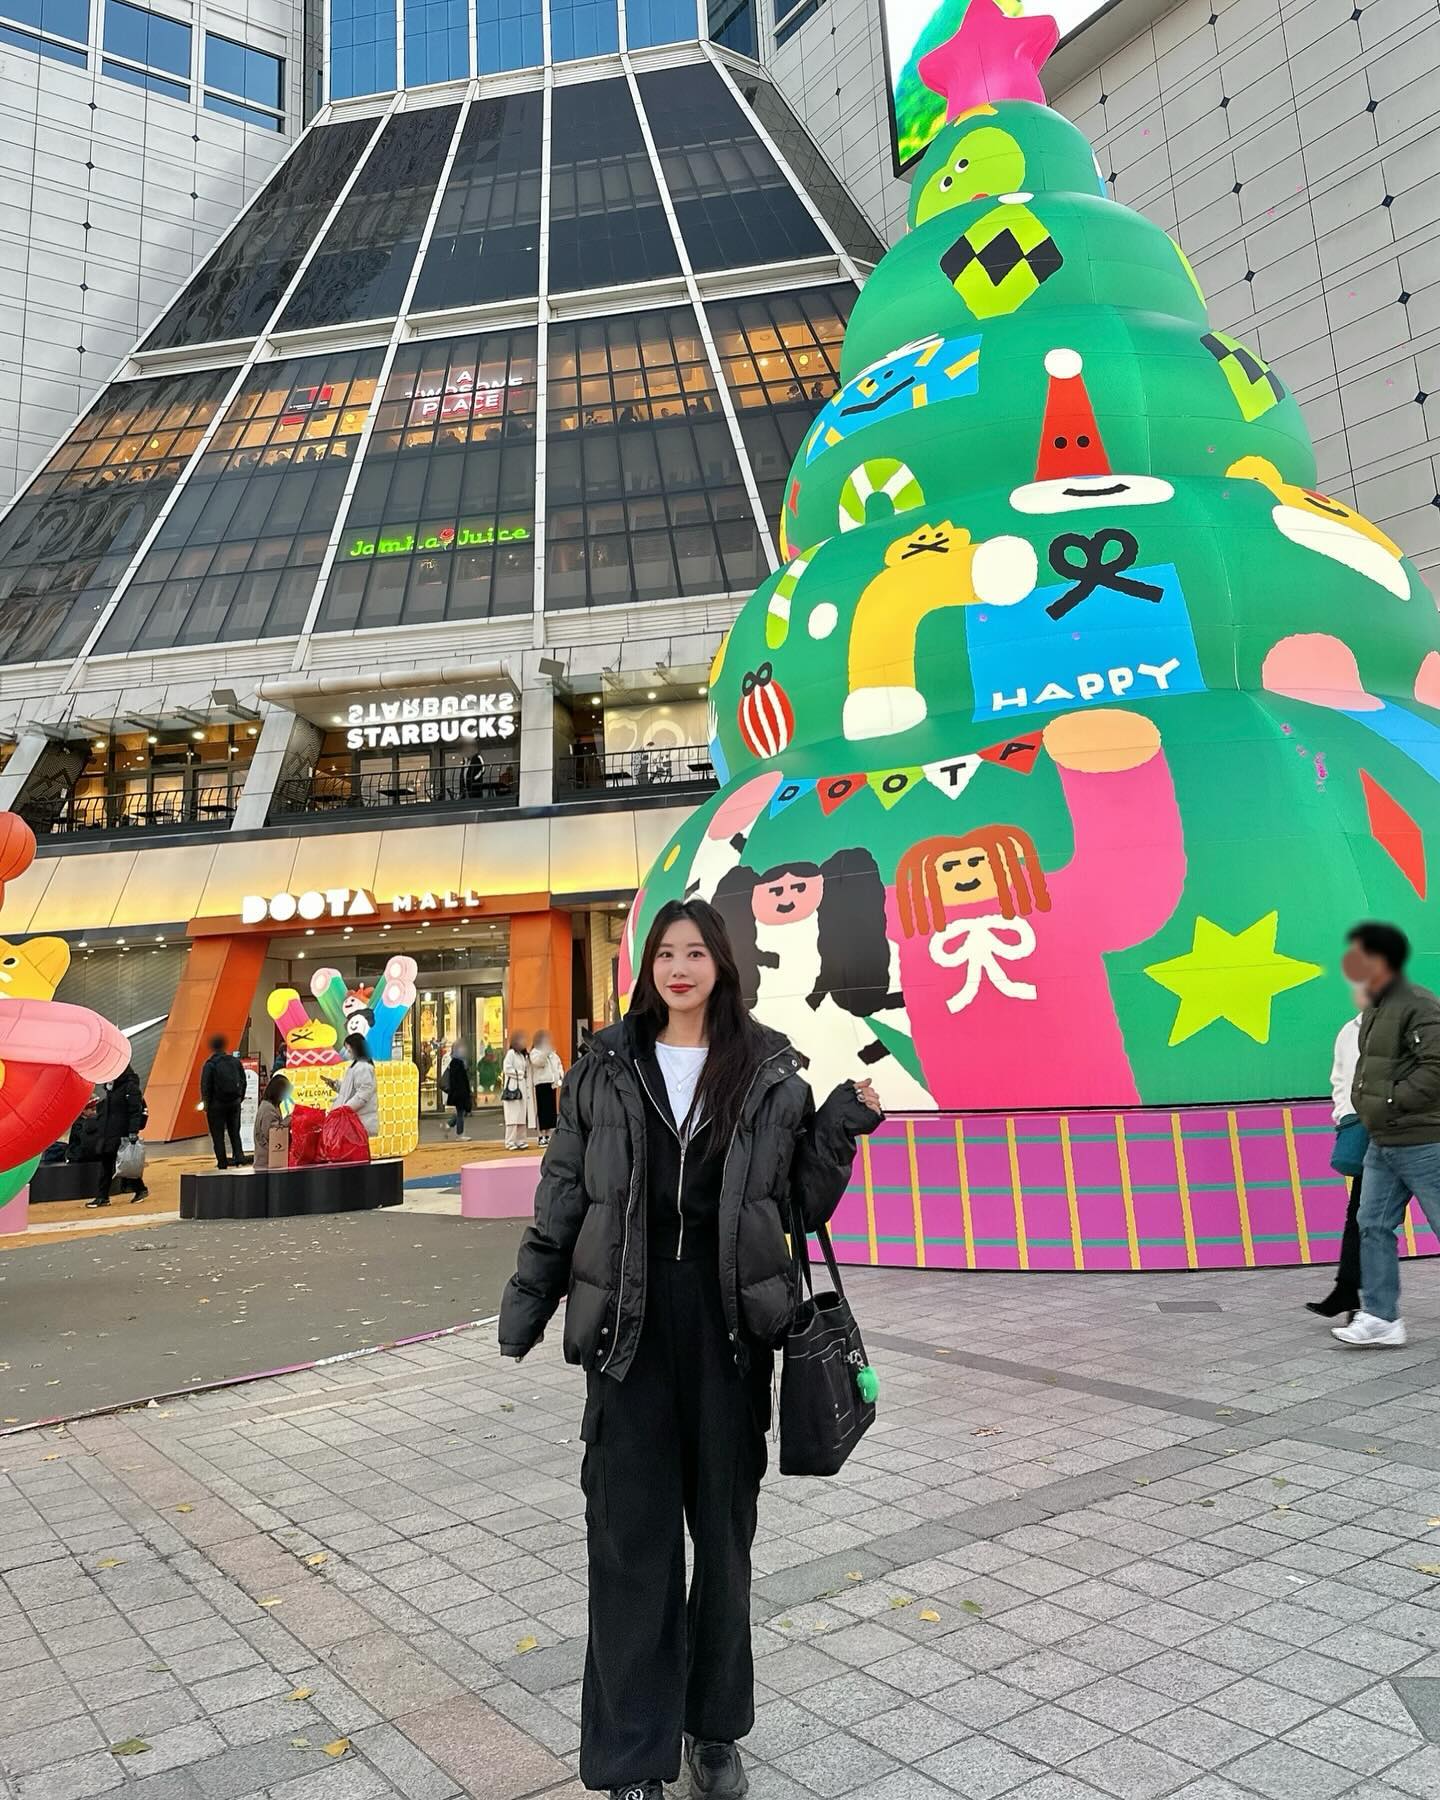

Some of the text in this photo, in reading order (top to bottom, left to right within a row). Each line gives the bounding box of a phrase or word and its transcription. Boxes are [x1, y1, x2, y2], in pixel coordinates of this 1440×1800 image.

[457, 371, 473, 383] A
[422, 394, 500, 416] PLACE
[458, 527, 530, 546] Juice
[992, 657, 1181, 711] HAPPY
[347, 715, 516, 749] STARBUCKS
[777, 742, 1036, 801] DOOTA
[242, 888, 481, 924] DOOTA MALL
[296, 1089, 333, 1098] WELCOME
